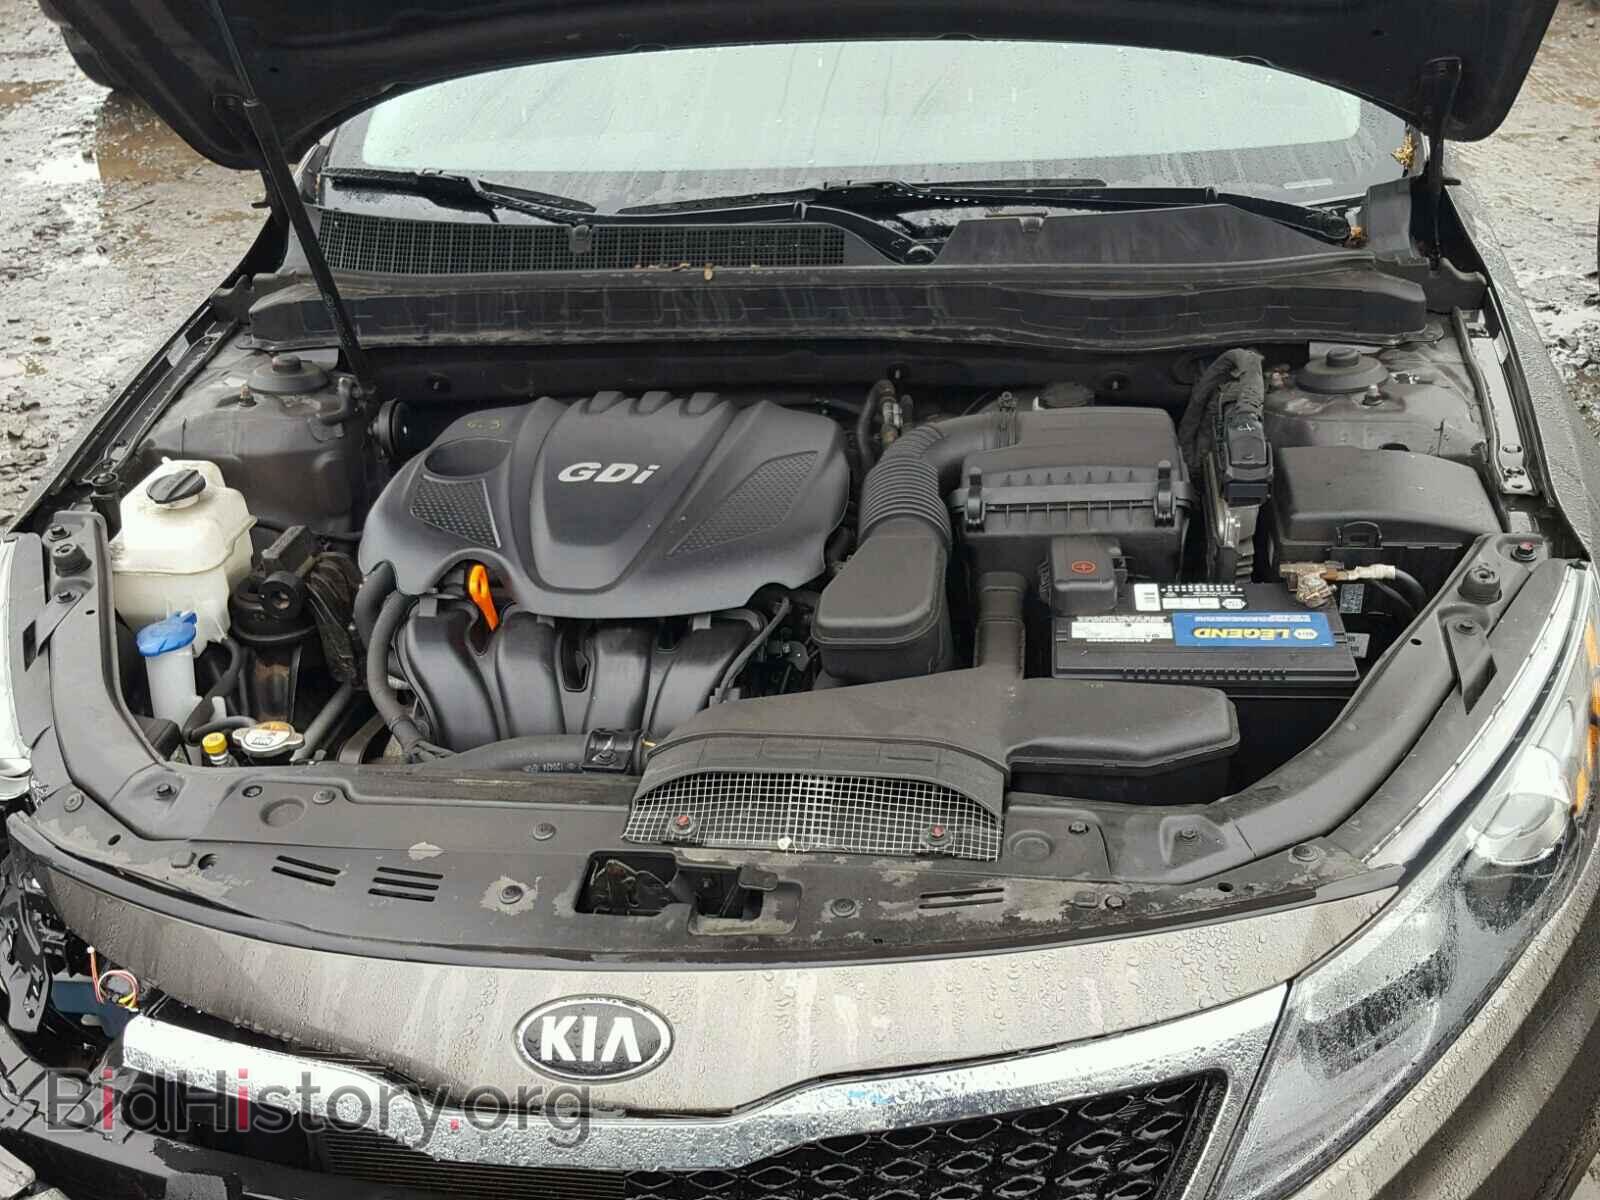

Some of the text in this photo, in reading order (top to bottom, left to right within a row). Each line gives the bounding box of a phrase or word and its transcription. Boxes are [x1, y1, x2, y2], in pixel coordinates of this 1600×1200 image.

[558, 462, 660, 484] GDi
[1193, 628, 1290, 641] LEGEND
[541, 1016, 642, 1062] KIA
